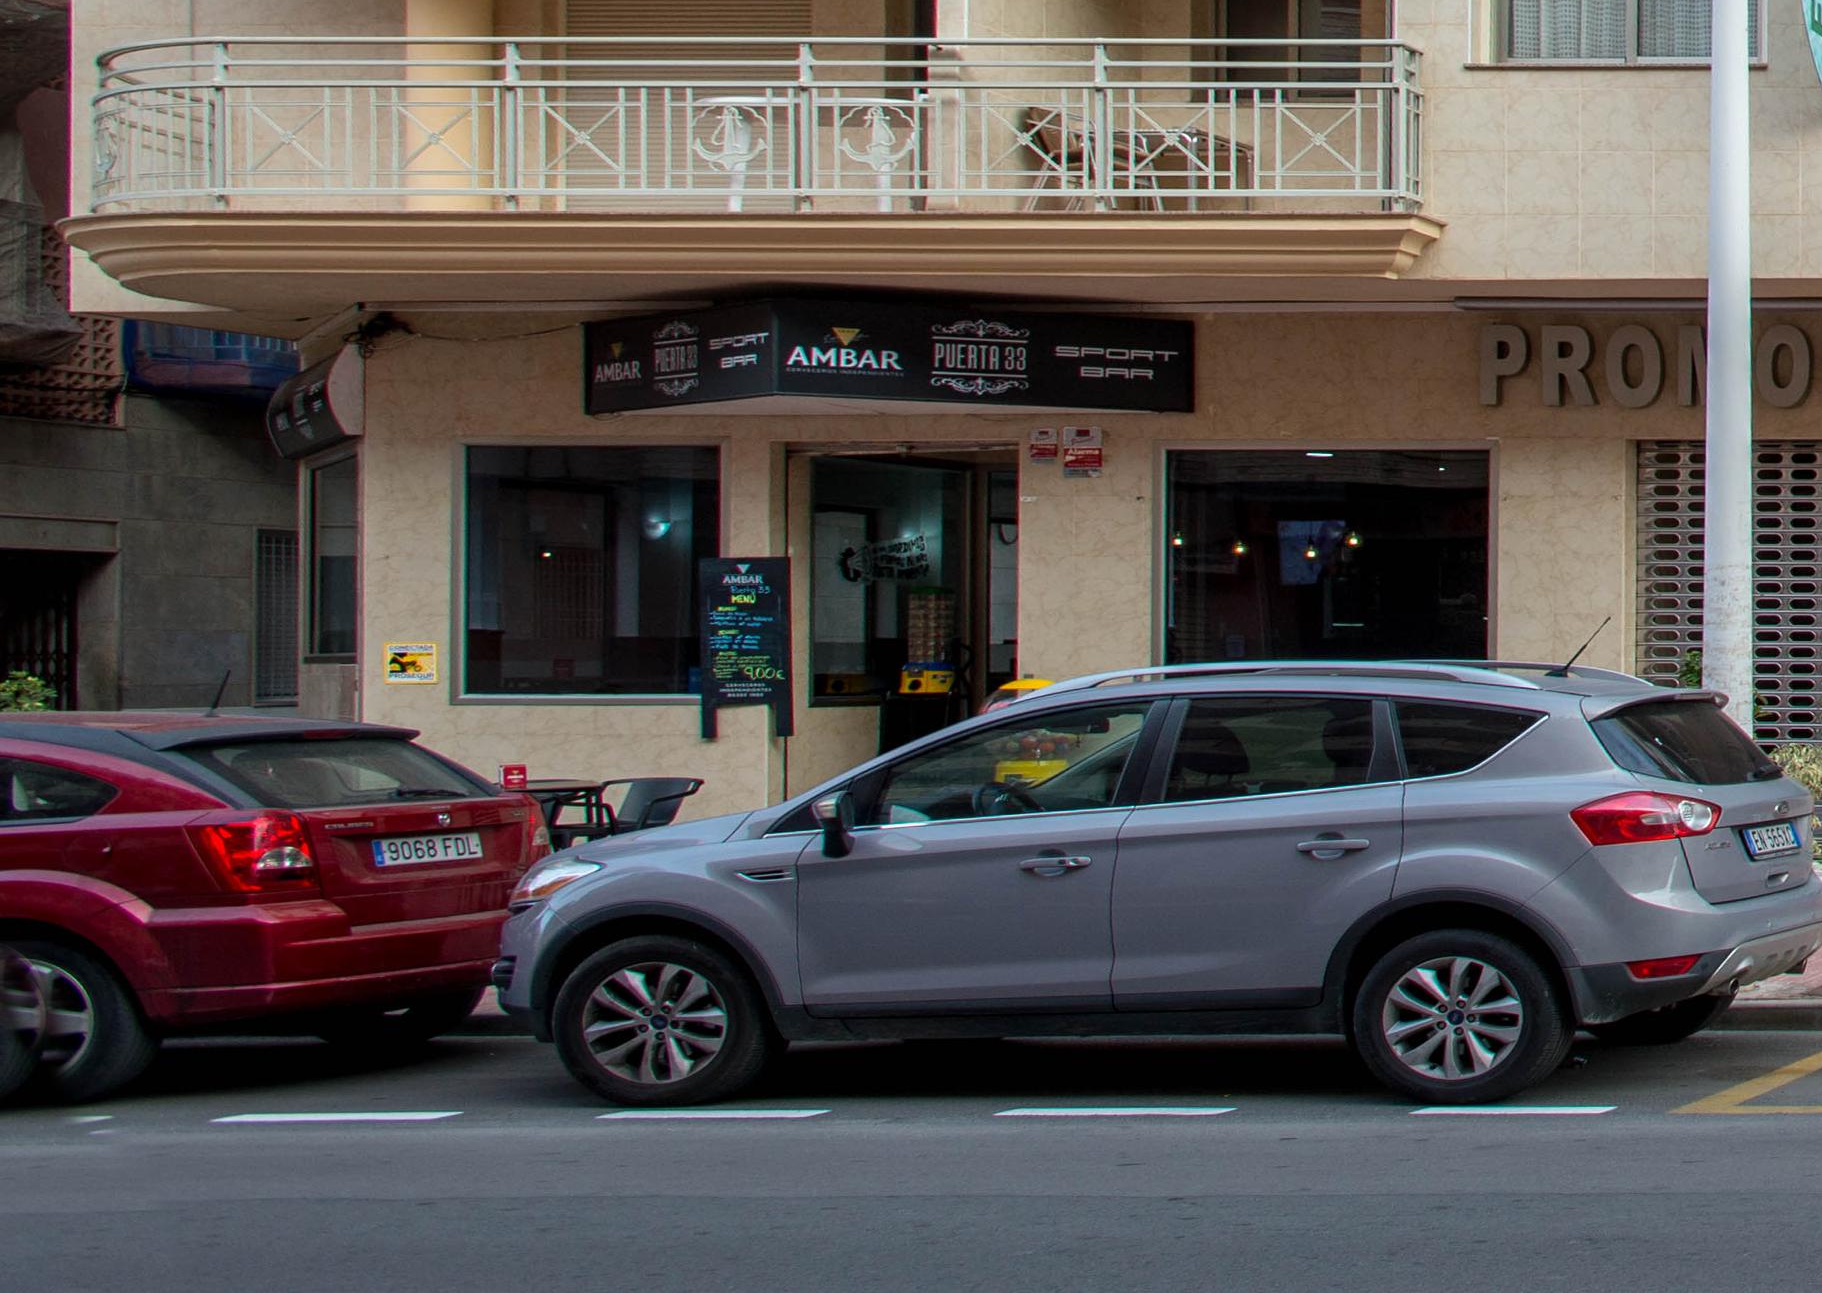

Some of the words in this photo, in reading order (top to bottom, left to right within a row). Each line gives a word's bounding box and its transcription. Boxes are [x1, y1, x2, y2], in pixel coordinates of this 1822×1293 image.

[708, 332, 770, 351] SPORT
[655, 346, 685, 373] PUERTA
[687, 344, 698, 368] 33
[720, 354, 757, 369] BAR
[787, 345, 904, 370] AMBAR
[934, 342, 999, 370] PUERTA
[1004, 346, 1027, 372] 33
[1055, 345, 1179, 362] SPORT
[594, 361, 641, 383] AMBAR
[1080, 365, 1154, 380] BAR
[723, 575, 763, 584] AMBAR
[388, 840, 438, 861] 9068
[443, 836, 478, 857] FDL
